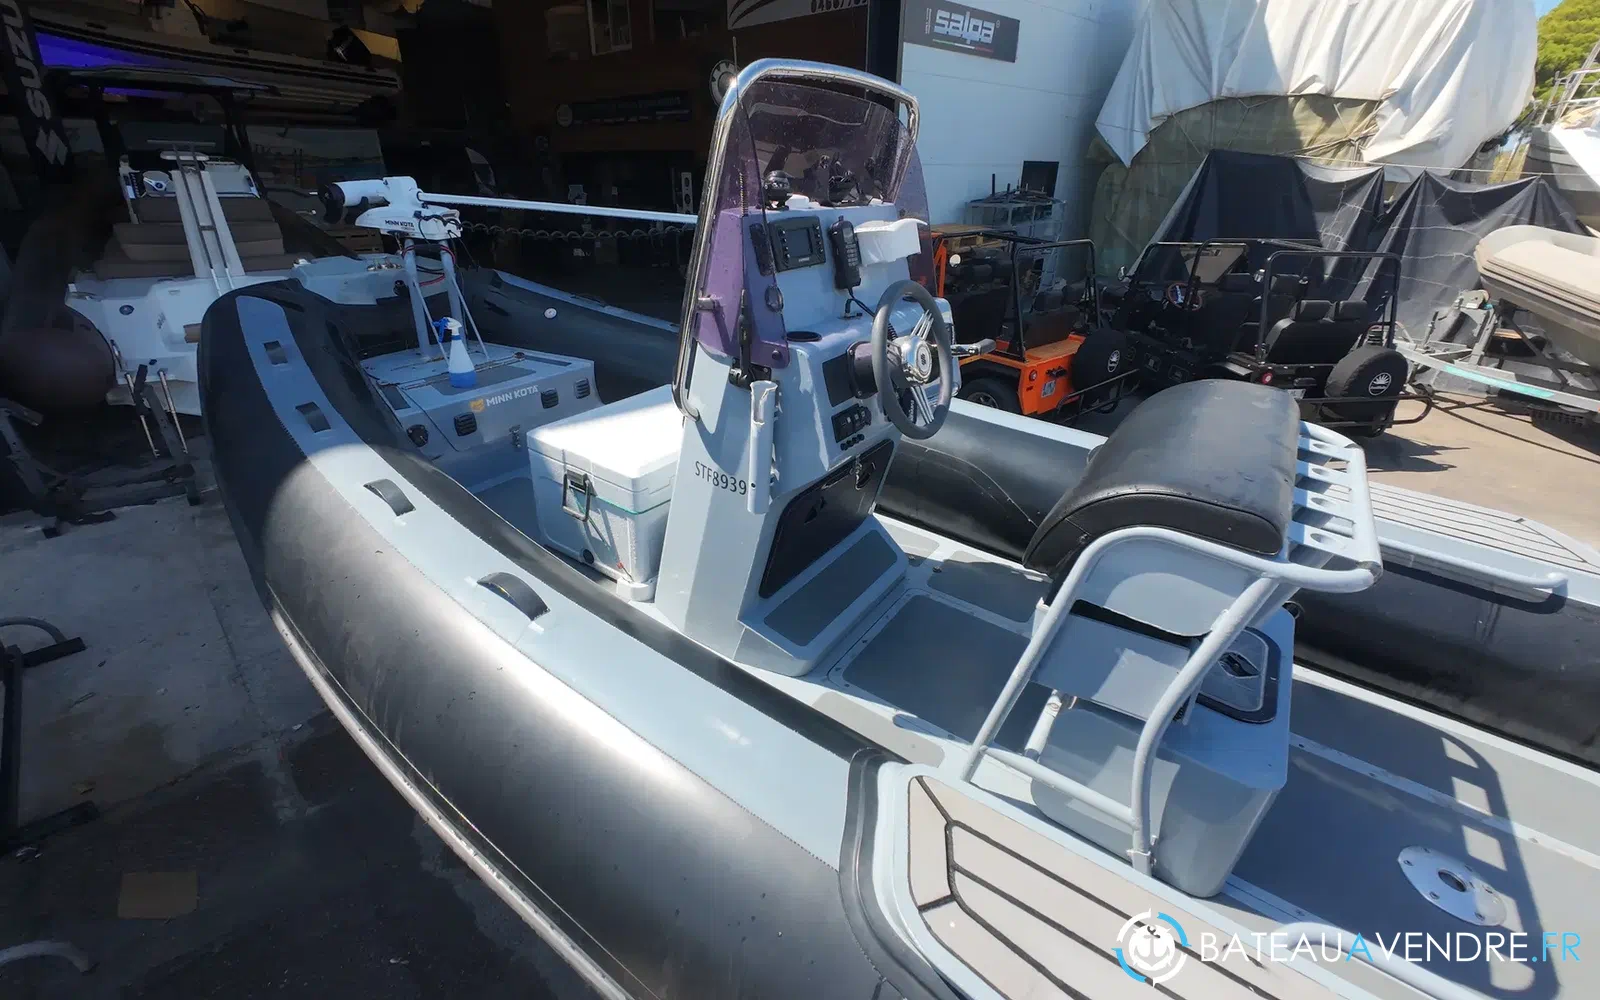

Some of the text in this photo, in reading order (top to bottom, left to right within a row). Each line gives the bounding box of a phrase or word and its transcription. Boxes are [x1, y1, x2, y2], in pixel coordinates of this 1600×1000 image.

[933, 9, 996, 45] salpa
[485, 385, 539, 407] MINN KOTA
[694, 460, 747, 495] STF8939
